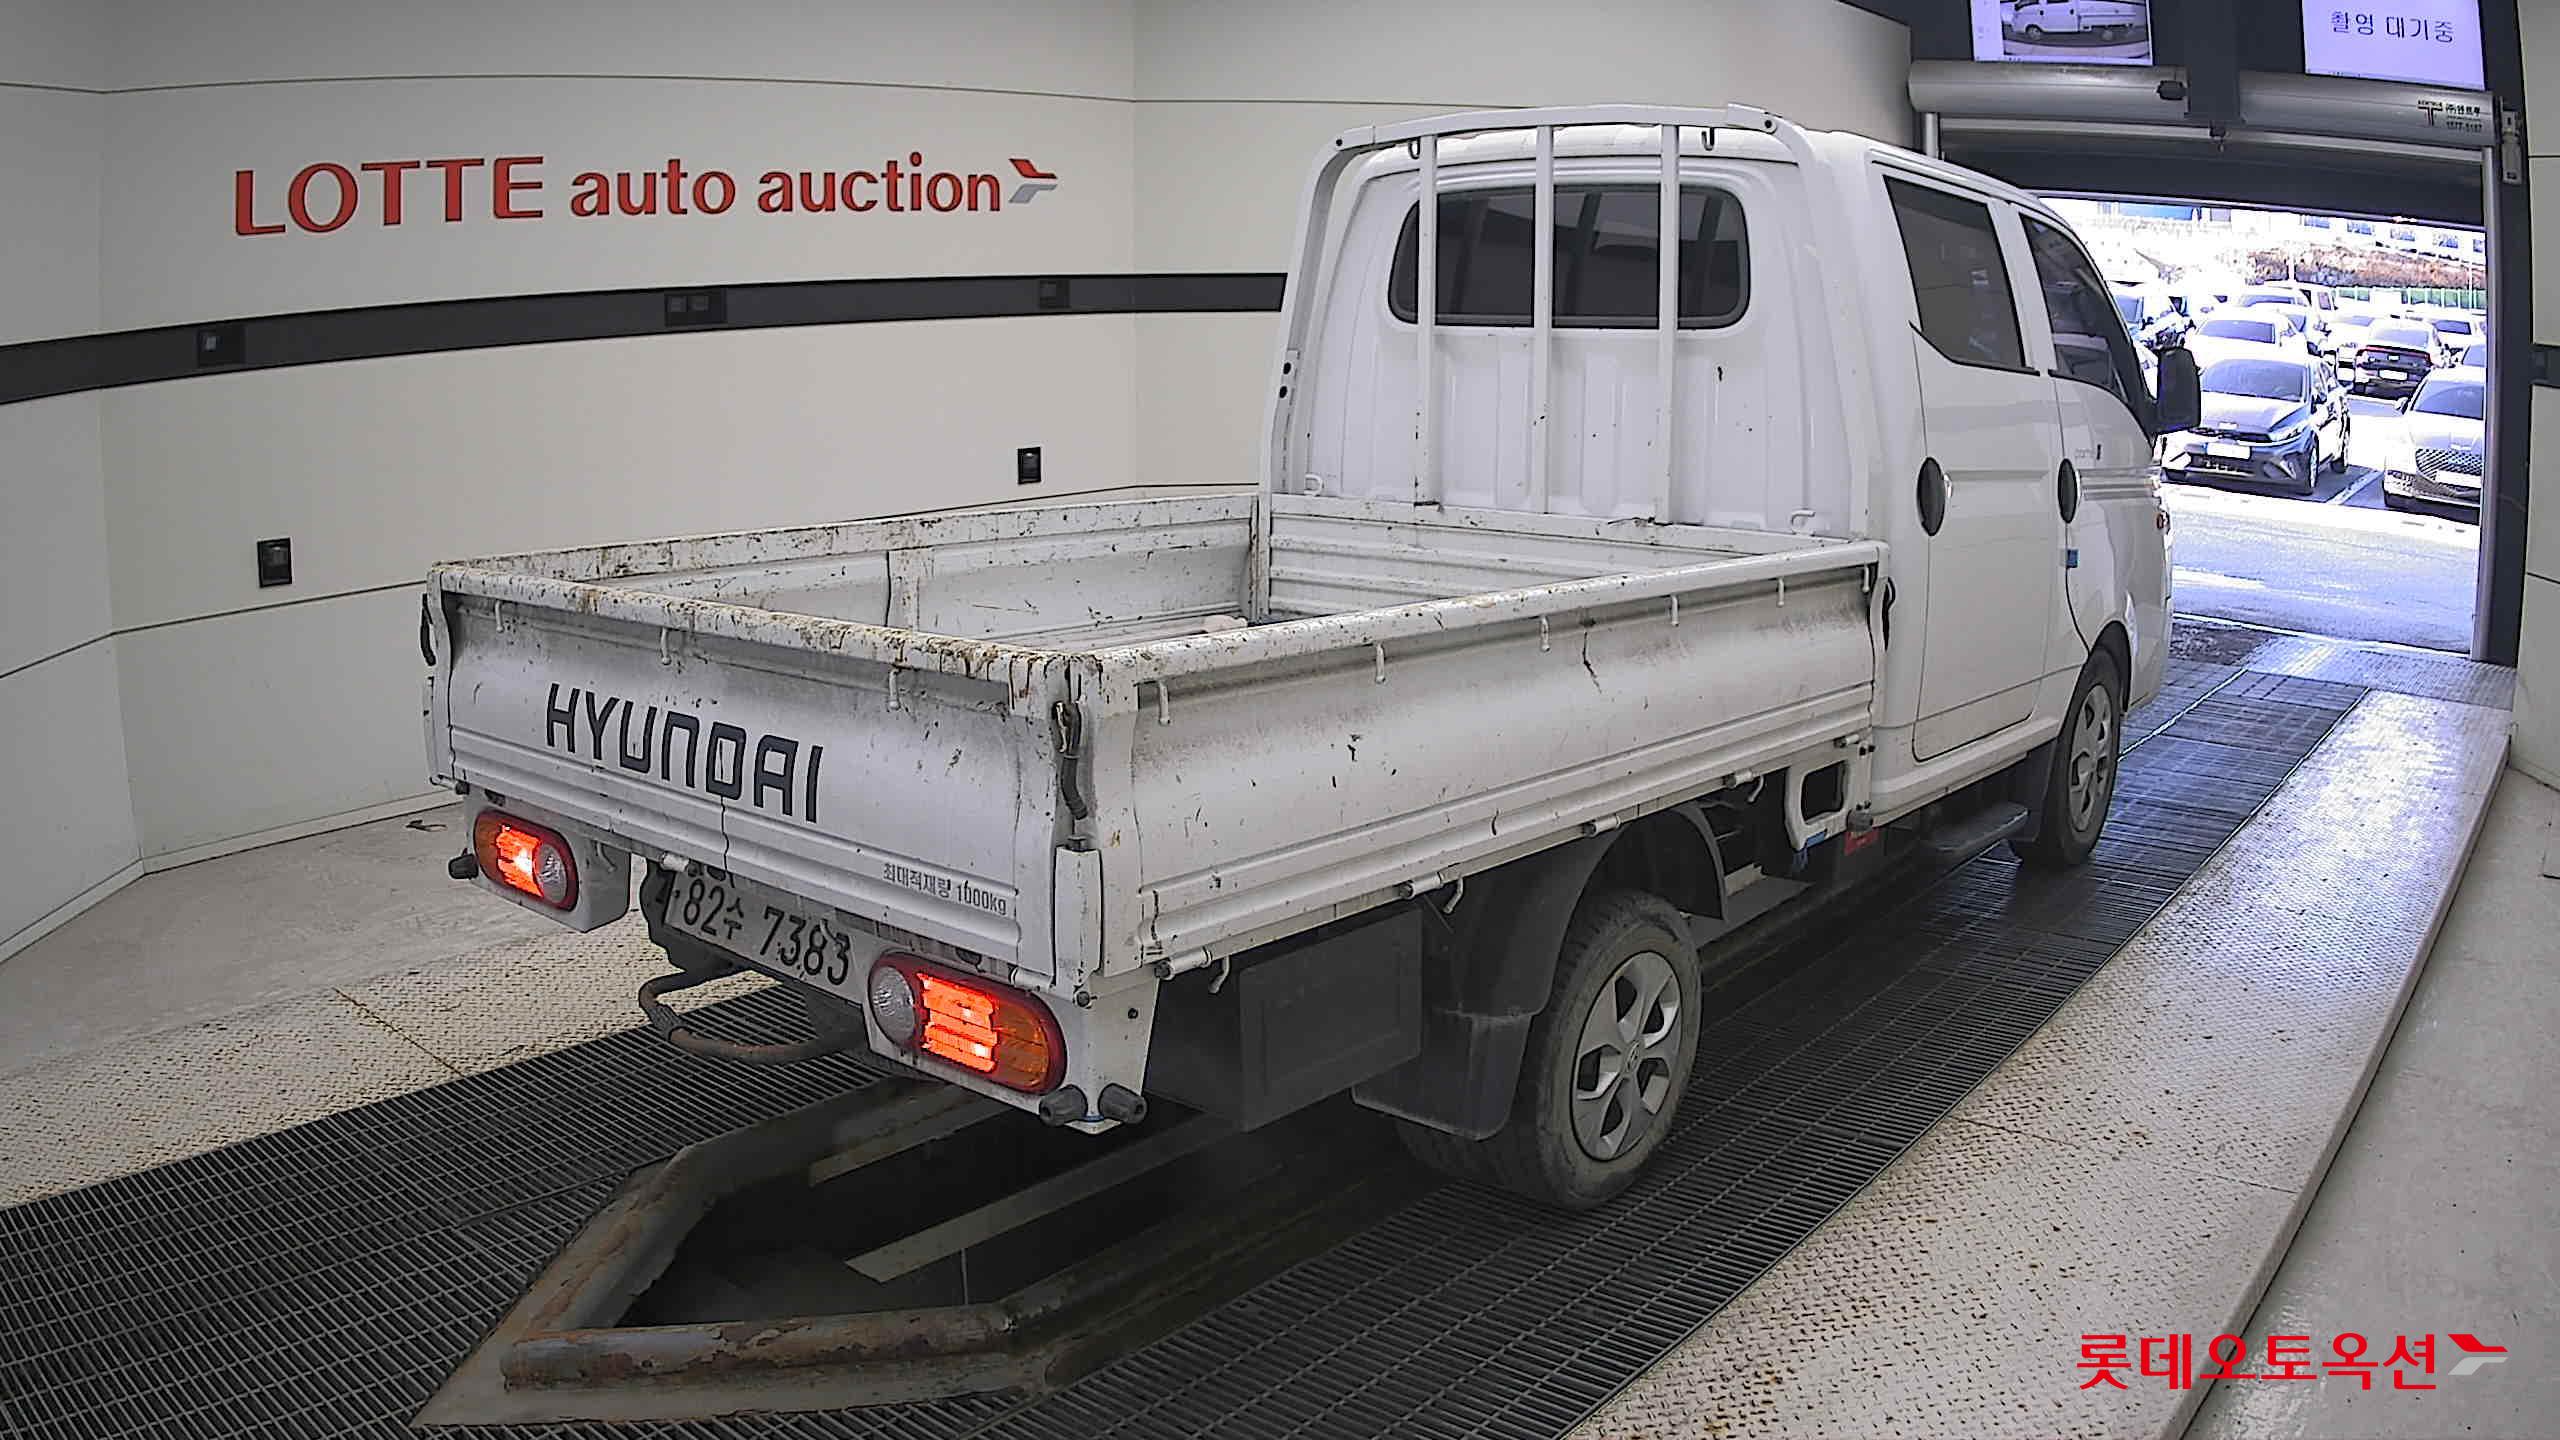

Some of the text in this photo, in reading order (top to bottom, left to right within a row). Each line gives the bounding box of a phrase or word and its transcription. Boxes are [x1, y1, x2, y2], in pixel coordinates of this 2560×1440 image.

[2331, 10, 2454, 43] 촬영 대기중
[236, 151, 1000, 236] LOTTE auto auction
[547, 683, 823, 823] HYUNDAI
[883, 863, 952, 898] 최대적재량
[683, 878, 851, 986] 82수 7383
